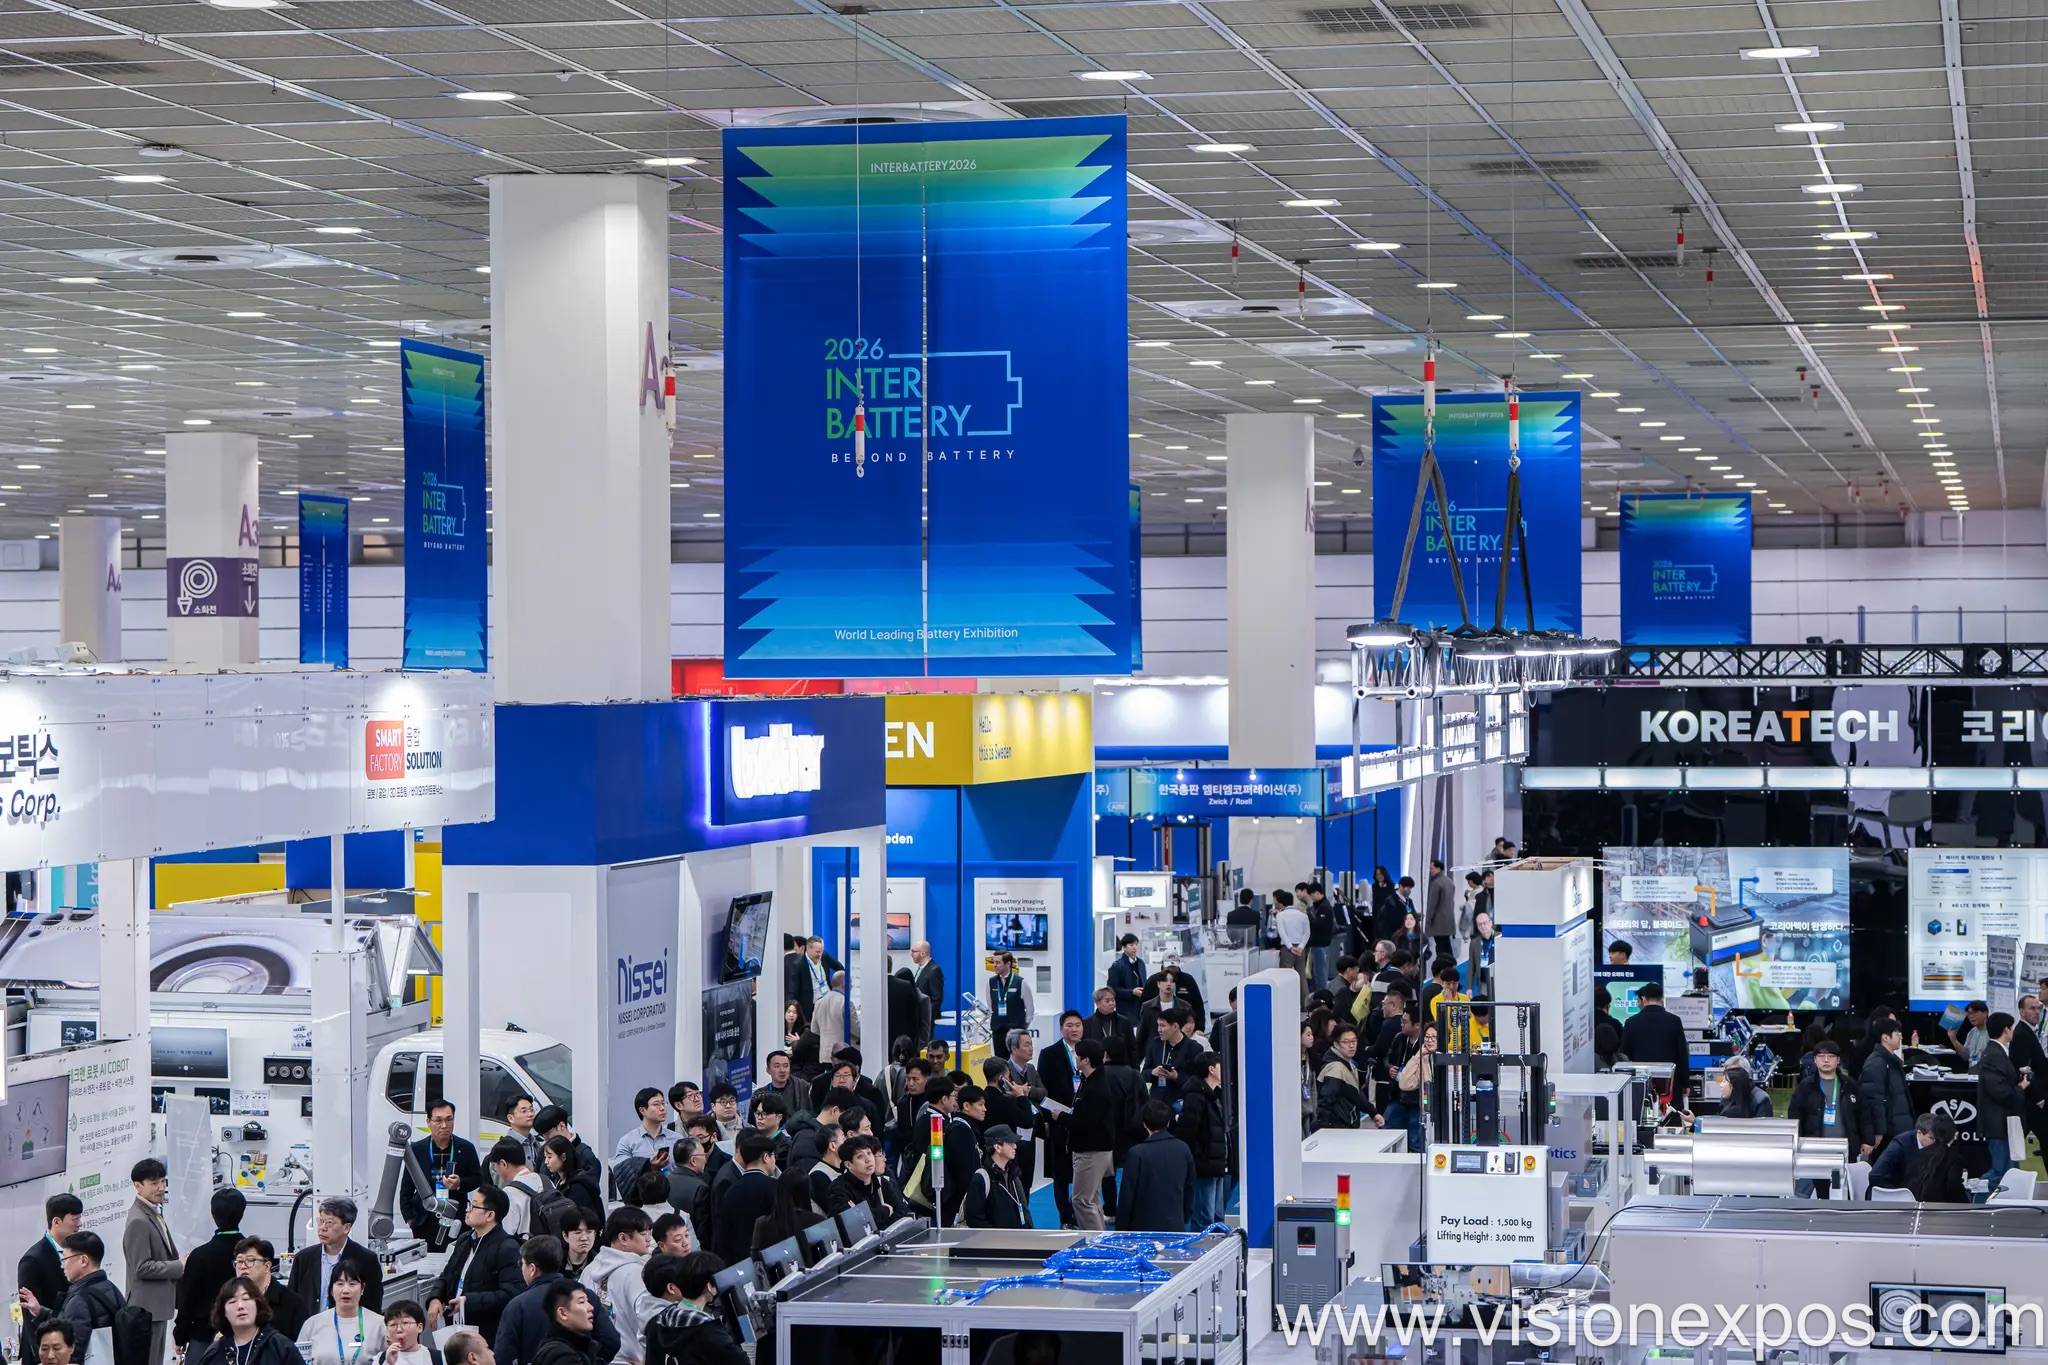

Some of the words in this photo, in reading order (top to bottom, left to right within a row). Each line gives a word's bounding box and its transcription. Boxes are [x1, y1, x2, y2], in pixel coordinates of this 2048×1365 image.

[870, 160, 976, 173] INTERBATTERY2026
[831, 338, 884, 360] 2026
[832, 366, 922, 400] INTER
[832, 404, 972, 440] BATTERY
[832, 452, 907, 464] BEOND
[422, 490, 446, 511] INTER
[422, 516, 457, 536] BATTERY
[1653, 582, 1700, 592] BATTERY
[834, 629, 866, 640] World
[870, 628, 914, 642] Leading
[963, 626, 1018, 639] Exhibition
[1640, 710, 1898, 742] KOREATECH
[1961, 710, 2048, 743] 코리
[376, 728, 402, 748] SMART
[370, 752, 403, 772] FACTORY
[407, 751, 442, 770] SOLUTION
[10, 790, 60, 822] Corp.
[618, 1010, 632, 1024] NISSEI
[633, 1002, 666, 1020] CORPORATION
[108, 1058, 129, 1074] COBOT
[1440, 1216, 1461, 1227] Pay
[1463, 1216, 1489, 1225] Load
[1497, 1219, 1518, 1227] 1,500
[1521, 1218, 1532, 1228] kg
[1437, 1231, 1461, 1243] Lifting
[1464, 1232, 1489, 1243] Height
